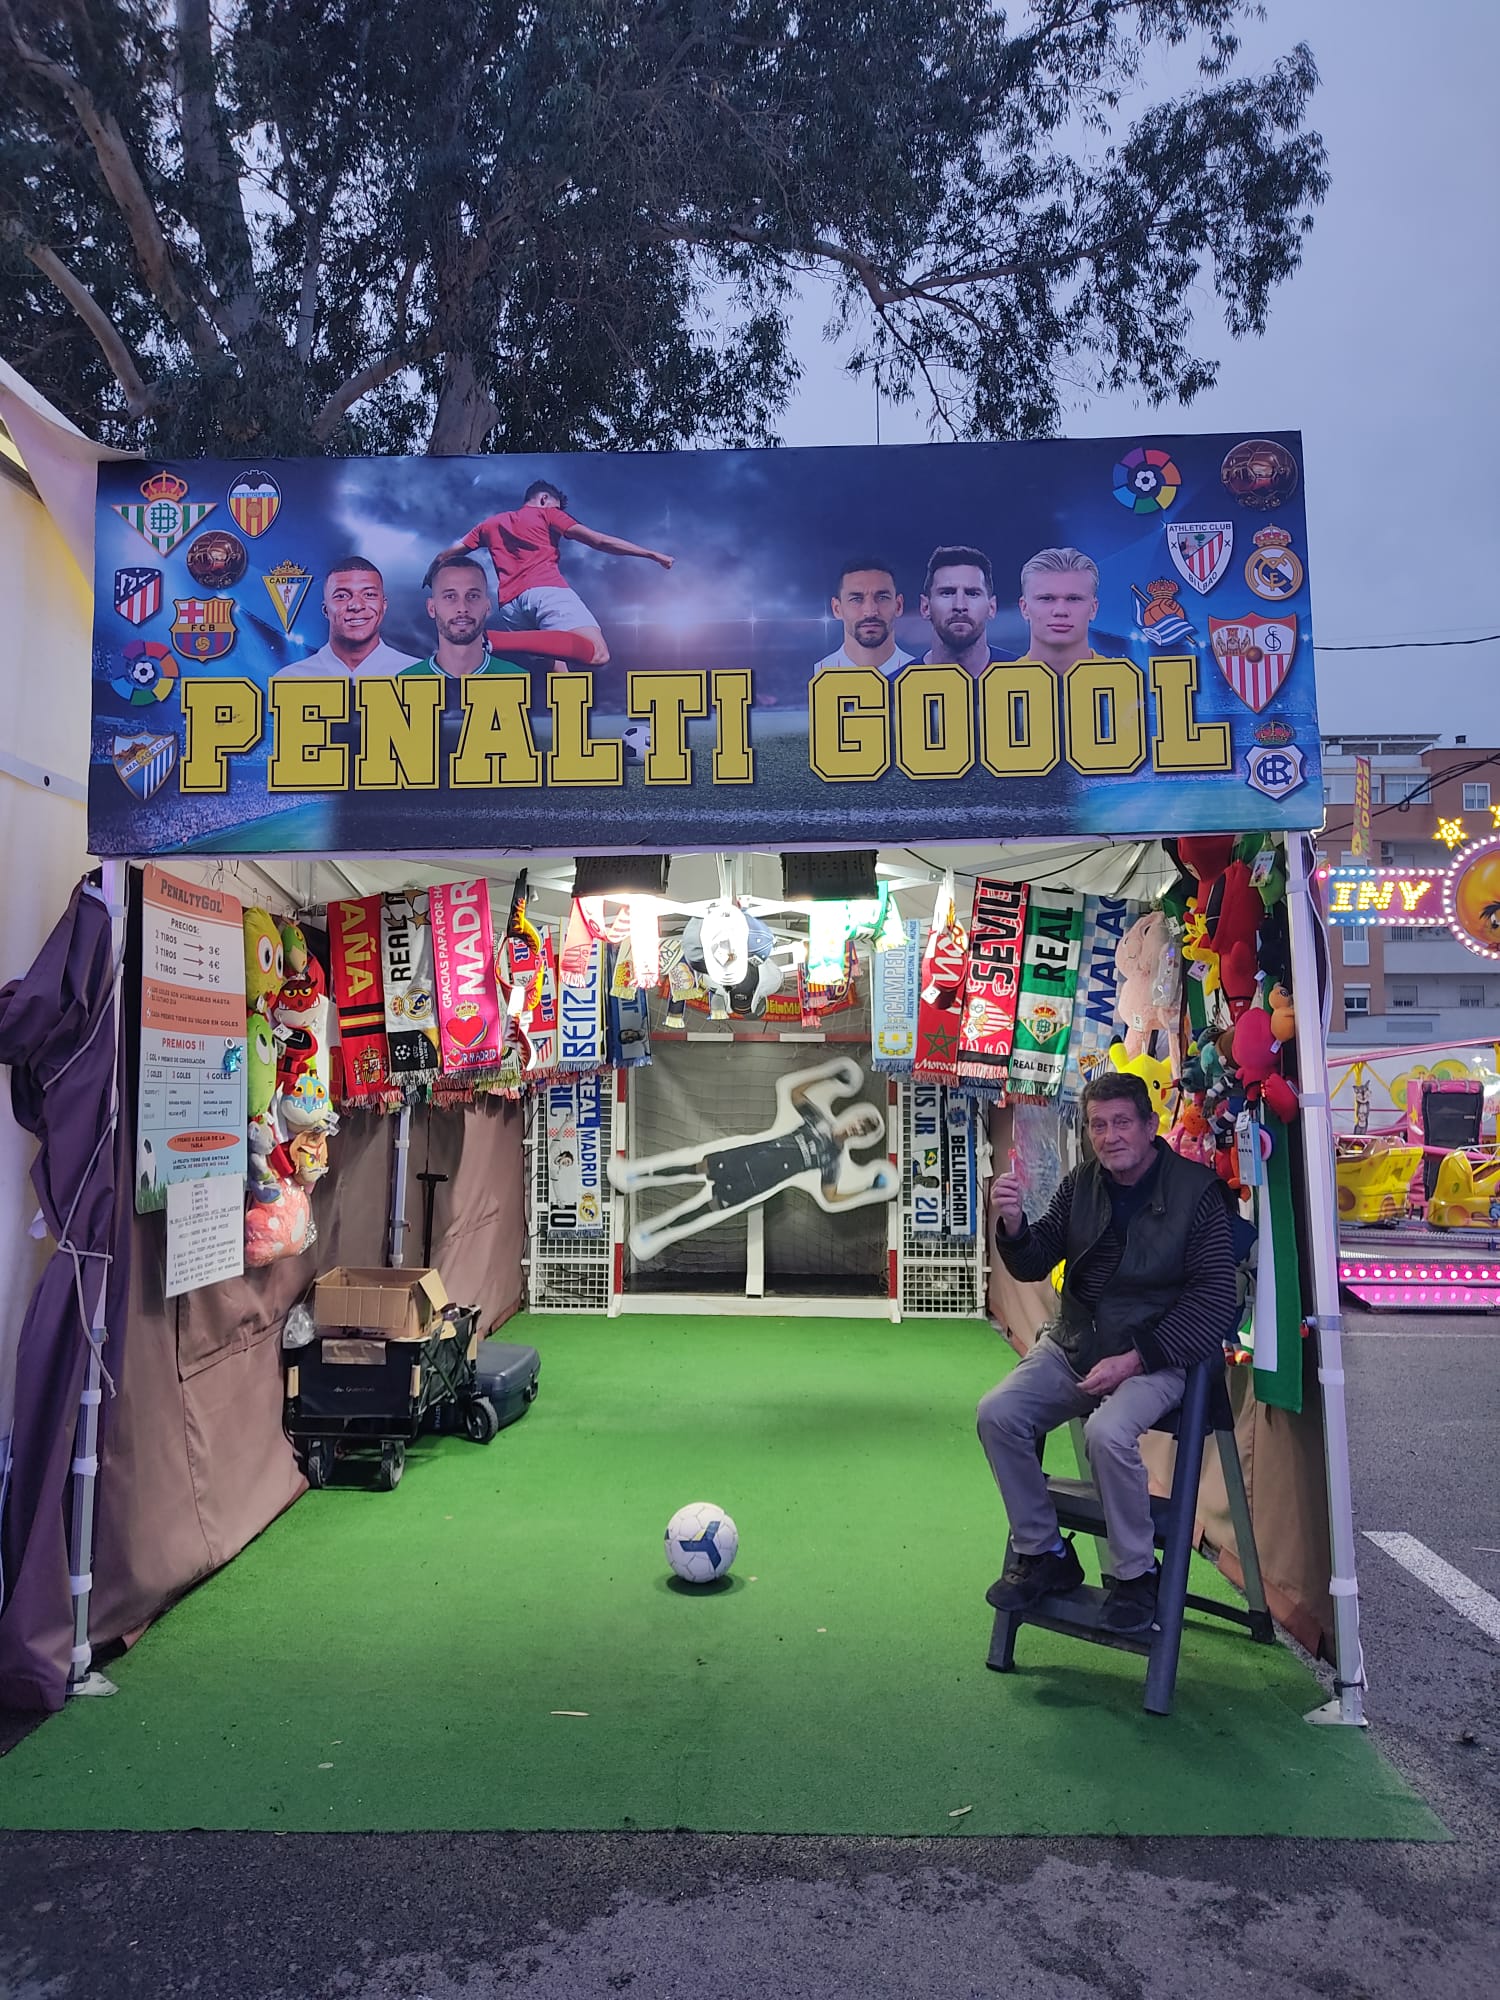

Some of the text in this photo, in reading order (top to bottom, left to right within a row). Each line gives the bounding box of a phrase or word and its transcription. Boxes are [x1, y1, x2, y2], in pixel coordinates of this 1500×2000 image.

[1168, 523, 1231, 532] ATHLETIC CLUB
[1188, 572, 1218, 591] BILBAO
[180, 655, 1233, 793] PENALTI GOOOL
[1329, 881, 1431, 912] INY
[170, 918, 200, 934] PRECIOS:
[433, 903, 444, 927] POR
[155, 929, 220, 956] 2 TIROS 3€
[909, 920, 917, 940] MUNDO
[155, 945, 220, 970] 3 TIROS 4€
[388, 915, 412, 983] REAL
[433, 928, 449, 960] PAPÁ
[1033, 907, 1073, 983] REAL
[160, 963, 177, 975] TIROS
[208, 974, 220, 984] 5€
[906, 955, 915, 984] CAMPEONA
[1199, 963, 1206, 972] 4
[437, 961, 452, 1008] GRACIAS
[540, 993, 555, 1021] DE
[905, 987, 914, 1019] ARGENTINA
[162, 1037, 197, 1050] PREMIOS
[1013, 1060, 1062, 1074] REAL BETIS
[579, 1075, 598, 1188] REAL MADRID
[1240, 1114, 1247, 1124] 2
[951, 1135, 968, 1227] BELLINGHAM
[550, 1201, 577, 1228] 10
[915, 1196, 939, 1224] 20
